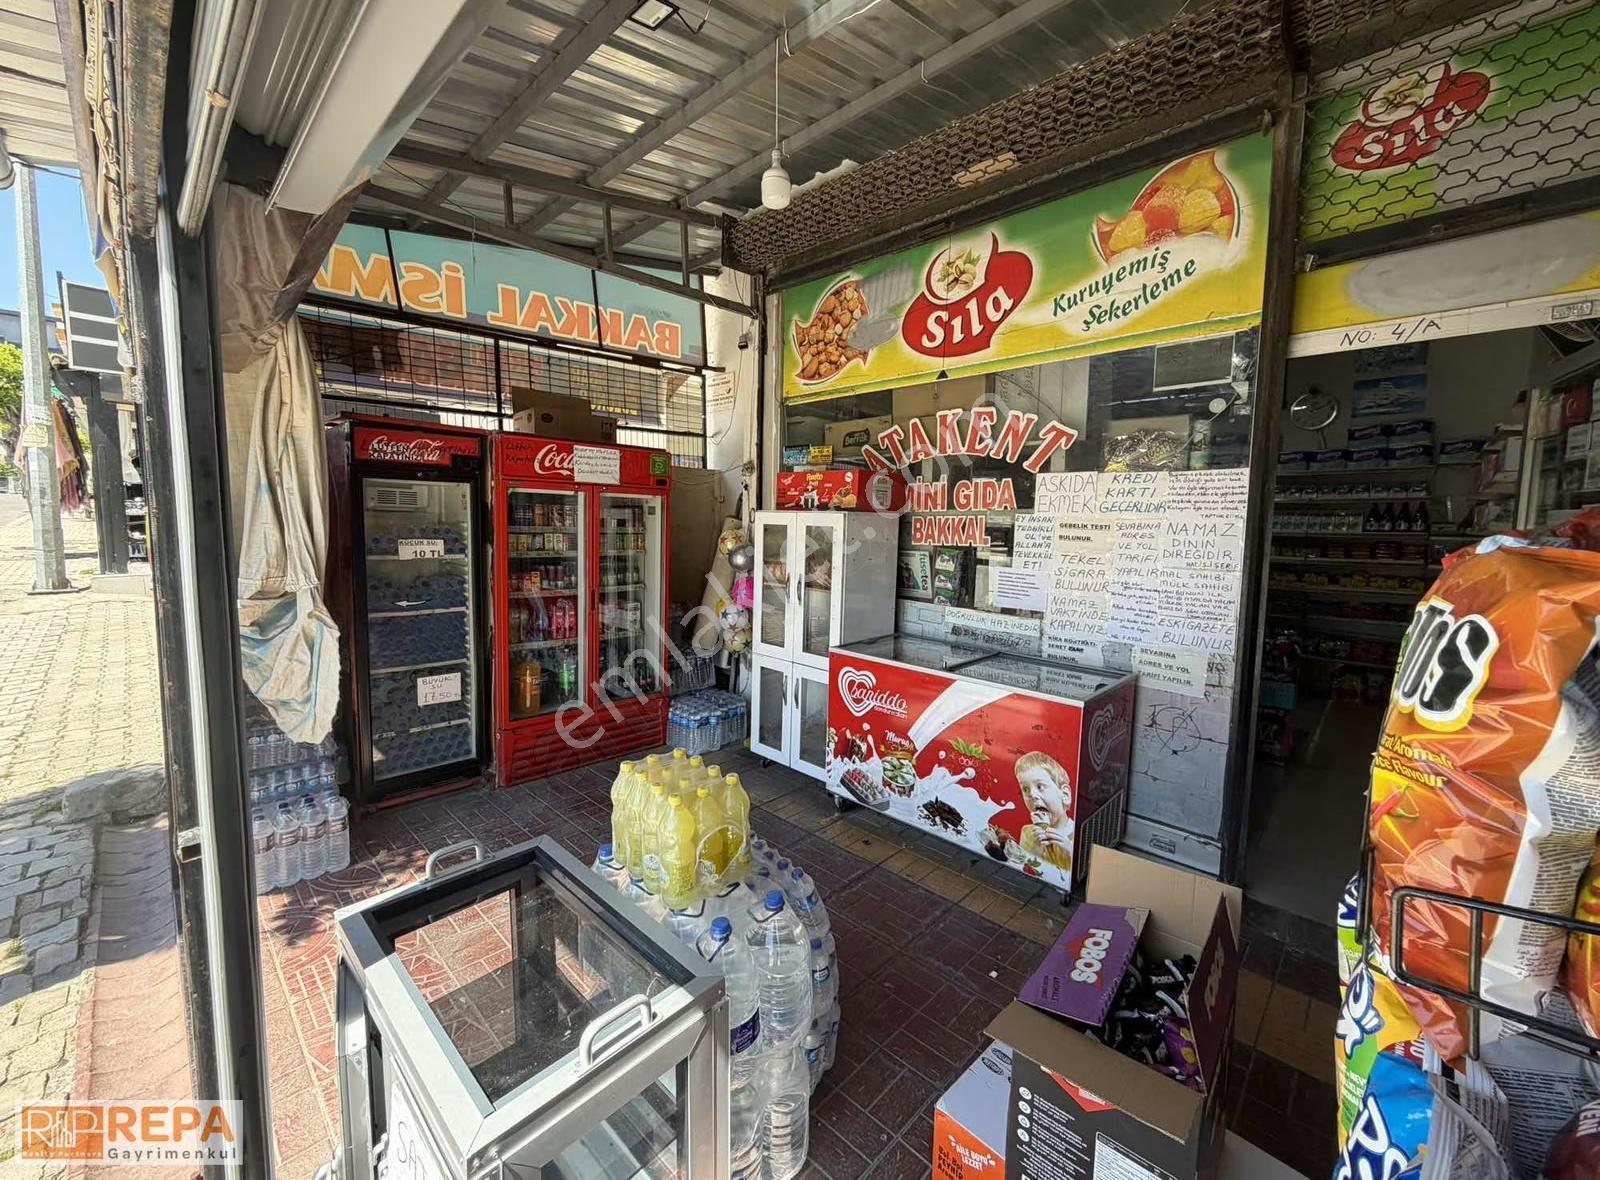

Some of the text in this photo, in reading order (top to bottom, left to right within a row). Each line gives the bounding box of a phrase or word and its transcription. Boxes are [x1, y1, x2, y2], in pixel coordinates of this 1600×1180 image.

[1052, 244, 1170, 317] Kuruyemiş
[1081, 256, 1198, 332] Şekerleme
[1339, 318, 1441, 347] NO: 4/A
[861, 407, 1079, 474] ATAKENT
[1038, 474, 1096, 493] ASKIDA
[954, 478, 1017, 512] GIDA
[1105, 487, 1157, 498] KARTI
[1037, 495, 1094, 513] EKMEK
[912, 515, 991, 547] BAKKAL
[1115, 522, 1161, 531] SEVABINA
[1166, 522, 1239, 537] NAMAZ
[1120, 532, 1155, 540] ADRES
[412, 550, 443, 558] 10 TL
[1136, 542, 1158, 551] YOL
[1060, 554, 1105, 565] TEKEL
[1054, 566, 1106, 579] SİGARA
[1055, 578, 1111, 593] BULUNUR
[1051, 596, 1098, 609] NAMAZ
[1162, 631, 1233, 653] BULUNUR
[1176, 665, 1191, 674] YOL
[1391, 758, 1449, 788] Flavour
[1069, 928, 1124, 984] FOBOS
